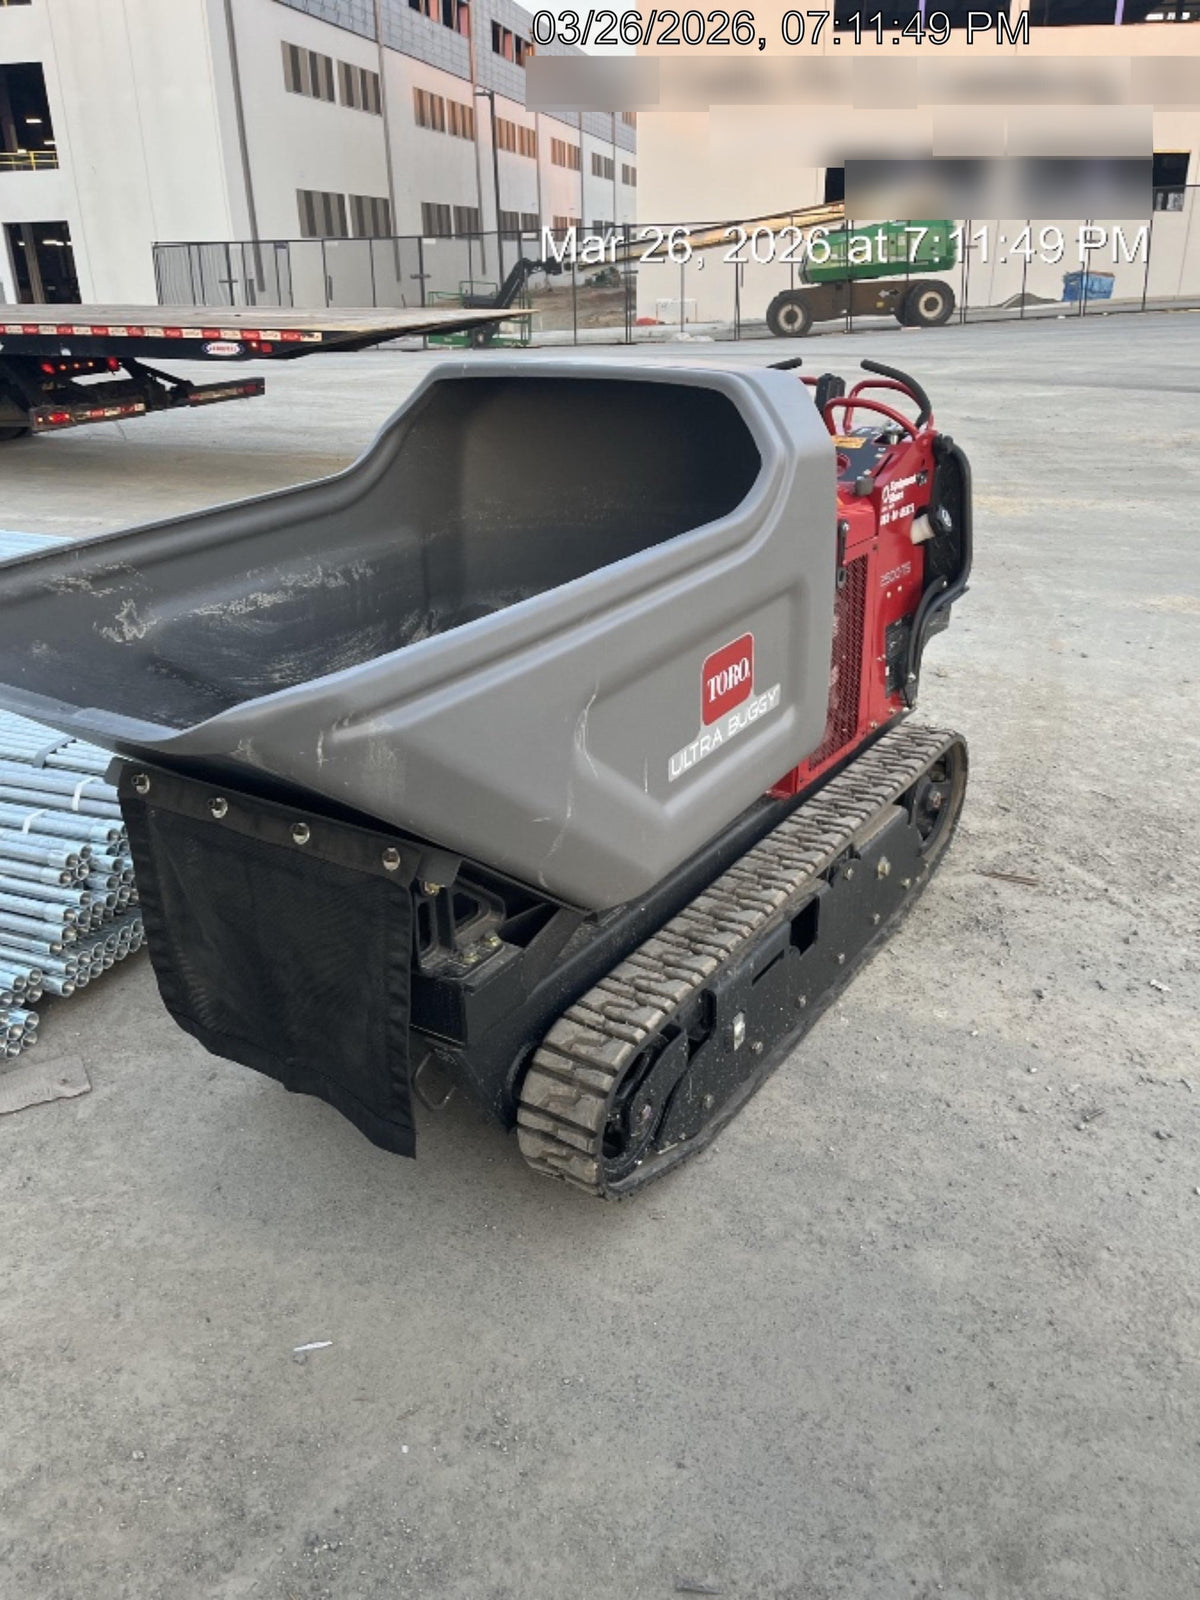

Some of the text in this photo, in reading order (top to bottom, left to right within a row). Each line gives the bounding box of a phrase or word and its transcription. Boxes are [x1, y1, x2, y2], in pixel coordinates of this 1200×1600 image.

[707, 657, 750, 703] TORO
[670, 692, 777, 776] ULTRA BUGGY
